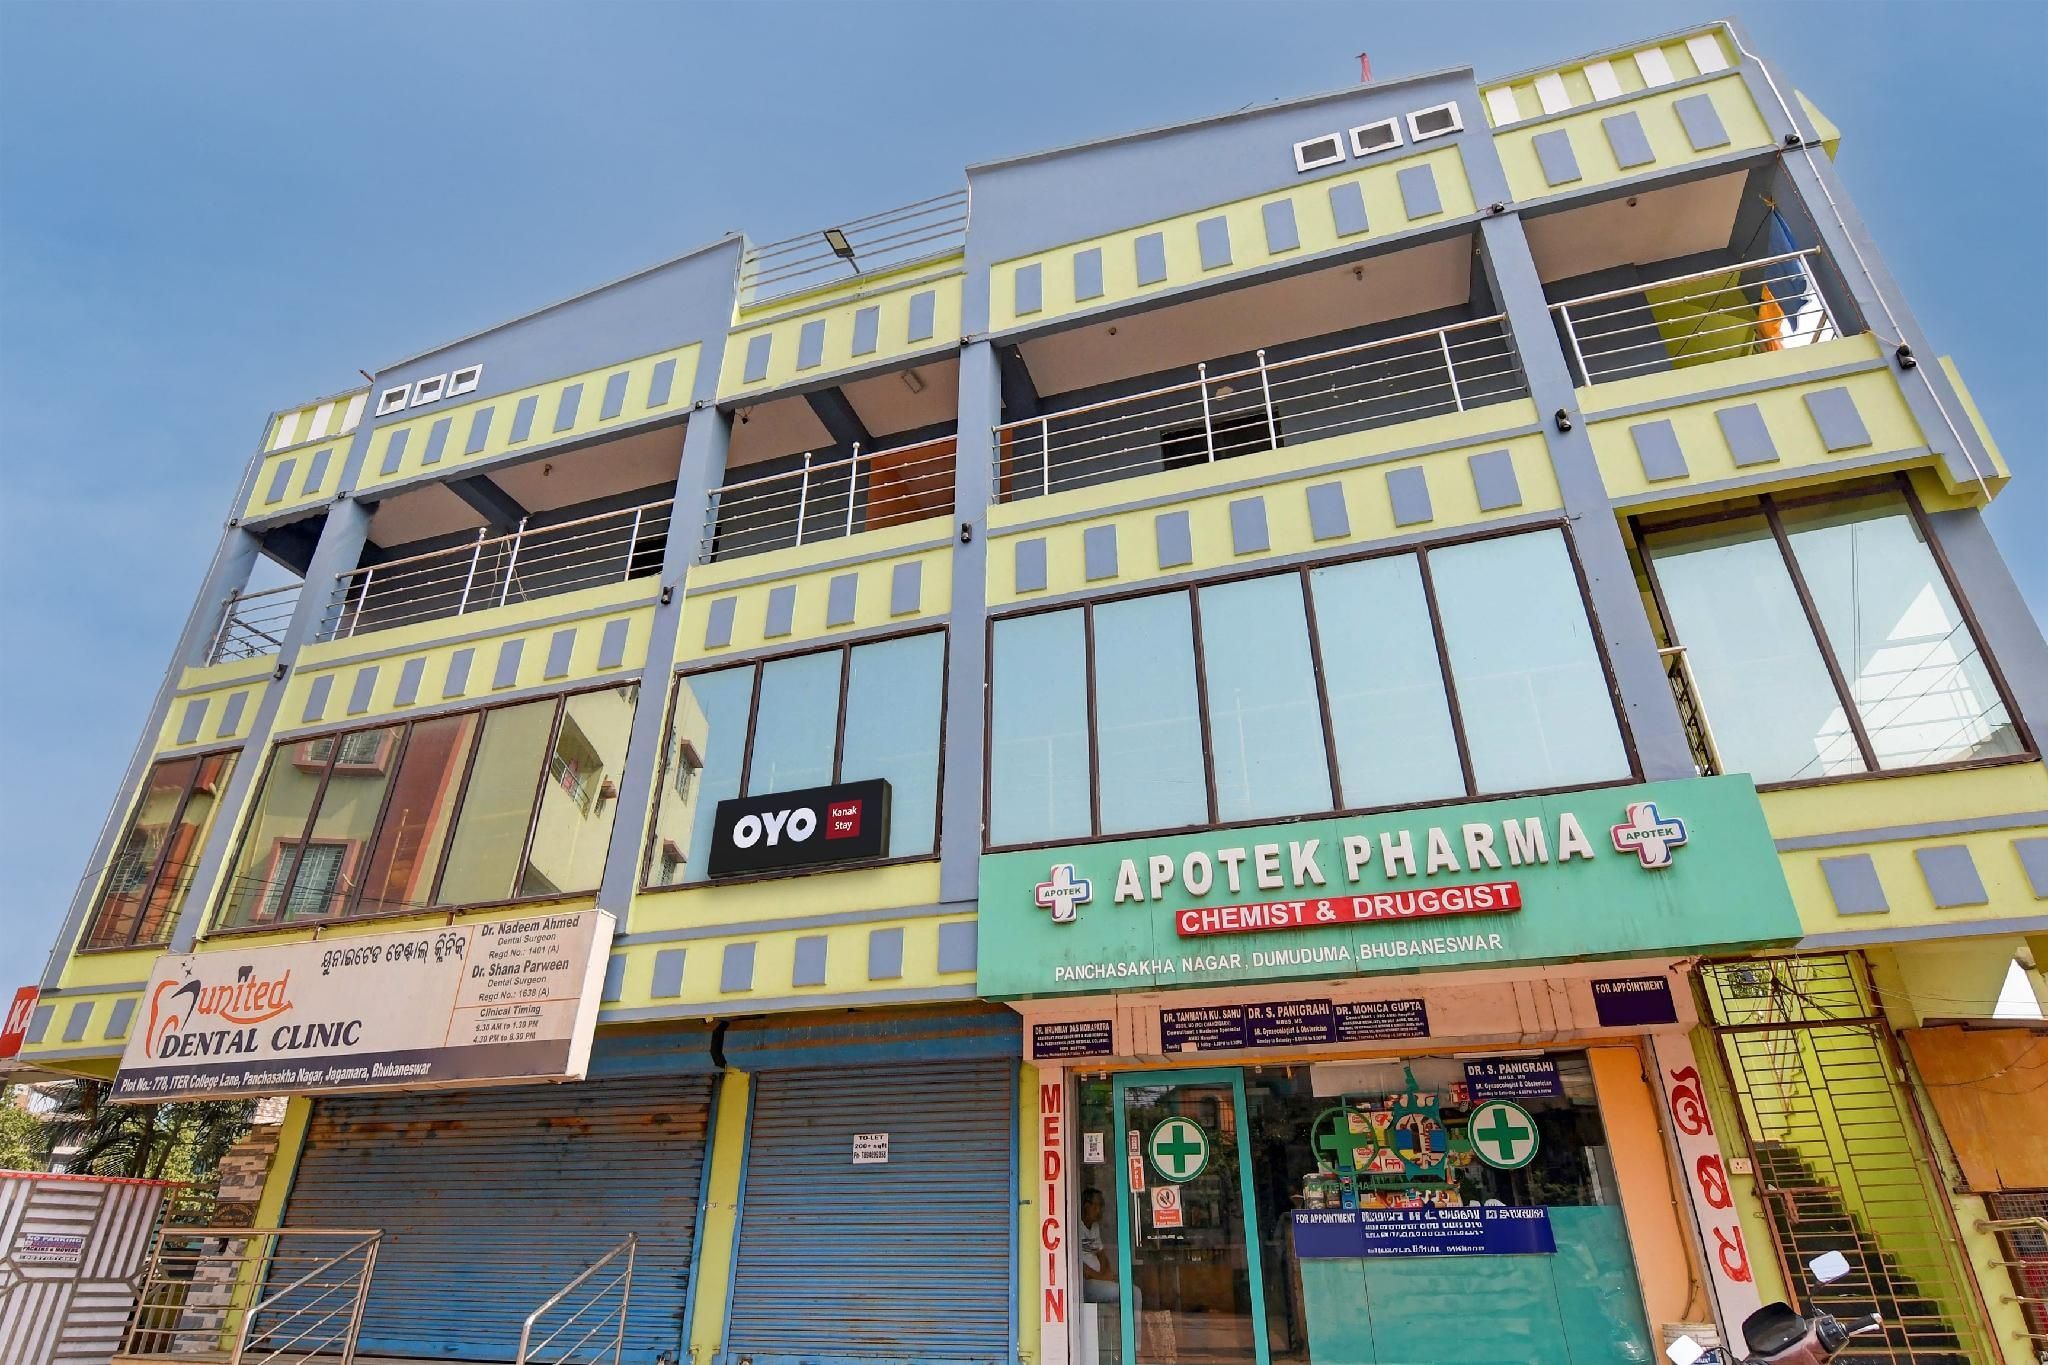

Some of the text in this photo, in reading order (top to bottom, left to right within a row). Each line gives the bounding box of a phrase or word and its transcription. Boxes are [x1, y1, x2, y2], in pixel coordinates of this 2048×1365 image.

[832, 805, 857, 817] Kanak
[732, 807, 817, 849] OYO
[834, 820, 853, 831] Stay
[1625, 826, 1674, 841] APOTEK
[1114, 812, 1596, 903] APOTEK PHARMA
[1044, 886, 1082, 898] APOTEK
[1182, 884, 1512, 933] CHEMIST & DRUGGIST
[481, 915, 580, 937] Dr. Nadeem Ahmed
[498, 933, 556, 946] Dental Surgeon
[489, 950, 508, 960] Regd
[547, 945, 560, 954] (A)
[472, 959, 569, 978] Dr. Shana Parween
[1055, 958, 1175, 982] PANCHASAKHA
[487, 976, 547, 988] Dental Surgeon
[1595, 980, 1664, 994] FOR APPOINTMENT
[197, 968, 293, 1018] united
[478, 992, 498, 1003] Regd
[519, 988, 537, 997] 1638
[538, 987, 550, 997] (A)
[480, 1005, 541, 1018] Clinical Timing
[1248, 1003, 1330, 1019] DR. S. PANIGRAHI
[1335, 1001, 1422, 1016] DR. MONICA GUPTA
[1163, 1013, 1176, 1023] DR.
[1208, 1010, 1222, 1020] KU.
[491, 1022, 502, 1031] AM
[503, 1022, 511, 1030] to
[528, 1019, 539, 1028] PM
[159, 1020, 362, 1059] DENTAL CLINIC
[489, 1034, 499, 1043] PM
[500, 1034, 508, 1042] to
[525, 1031, 536, 1040] PM
[1467, 1061, 1554, 1076] DR. S. PANIGRAHI
[120, 1078, 137, 1093] Plot
[169, 1075, 188, 1089] ITER
[189, 1073, 217, 1091] College
[219, 1073, 241, 1089] Lane,
[241, 1068, 295, 1086] Panchasakha
[296, 1068, 323, 1085] Nagar,
[325, 1065, 370, 1085] Jagamara,
[371, 1062, 432, 1079] Bhubaneswar
[1041, 1083, 1065, 1323] MEDICIN
[1295, 1213, 1309, 1224] FOR
[1310, 1212, 1356, 1224] APPOINTMENT
